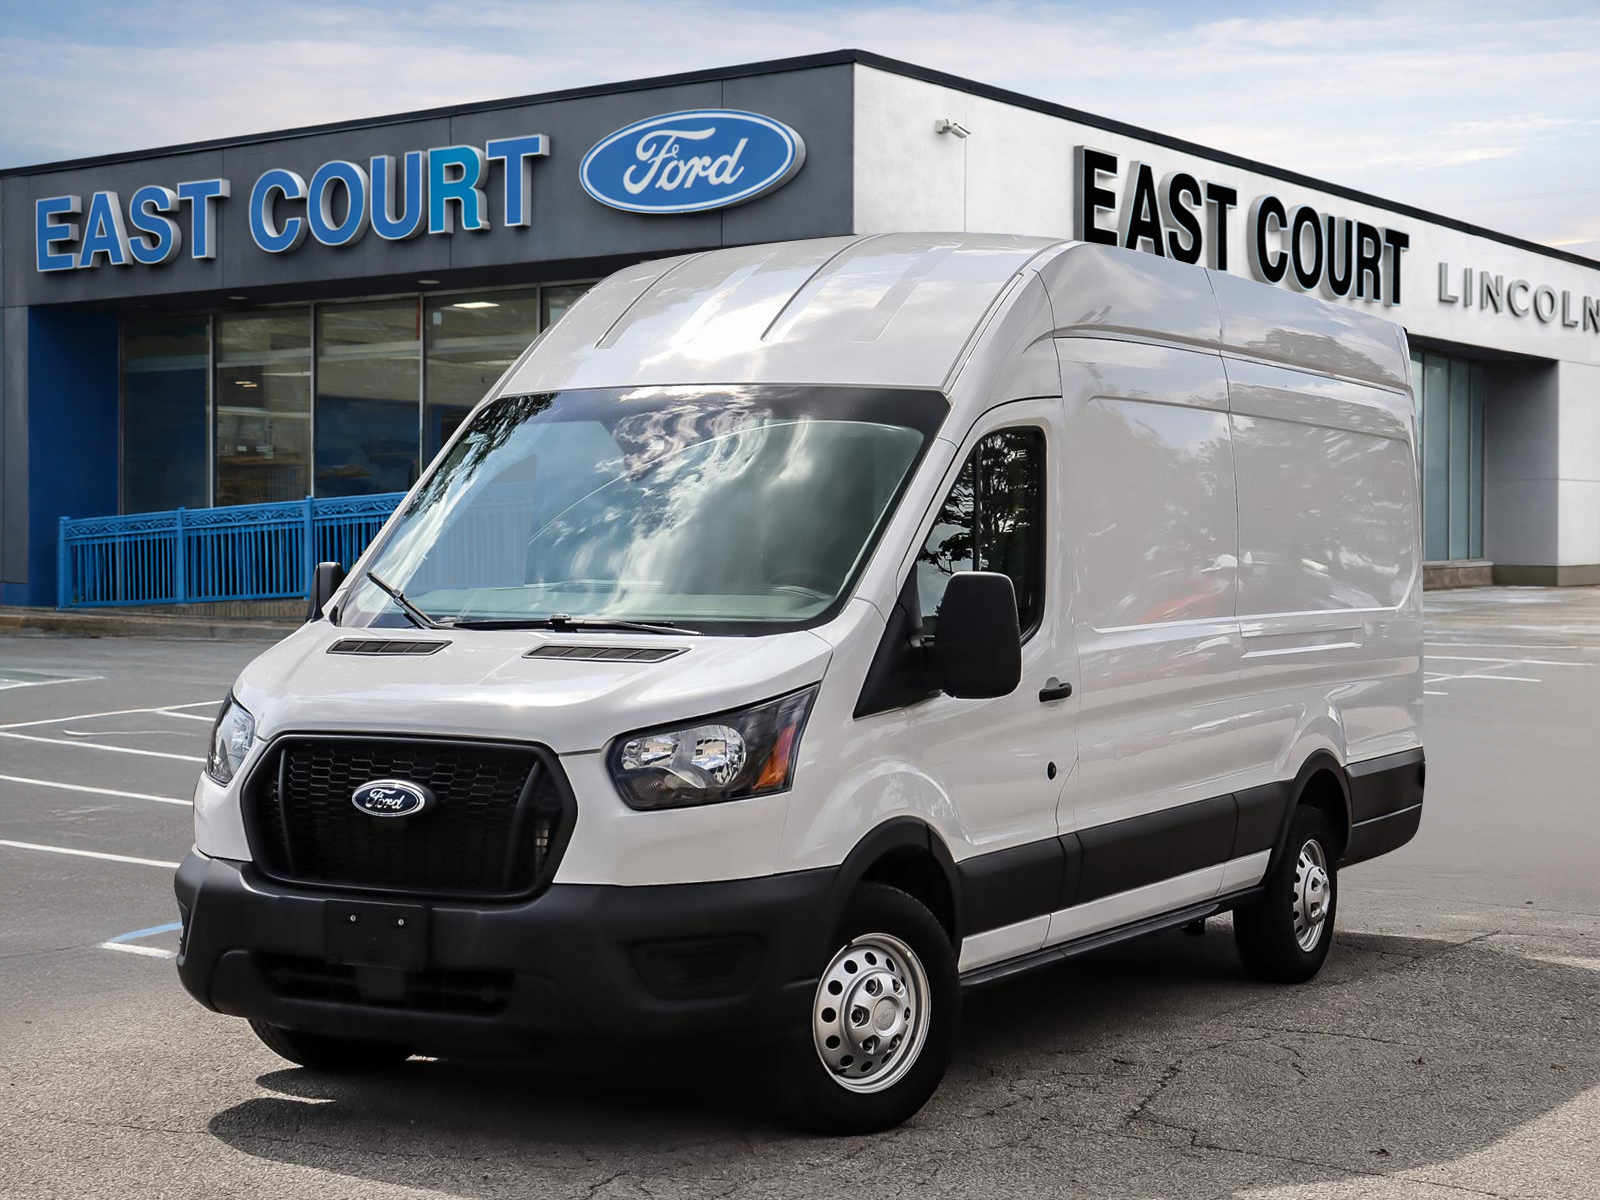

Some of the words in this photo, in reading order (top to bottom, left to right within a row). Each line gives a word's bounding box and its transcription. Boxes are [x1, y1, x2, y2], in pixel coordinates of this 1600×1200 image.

[36, 177, 230, 272] EAST
[249, 133, 550, 253] COURT
[623, 127, 749, 195] Ford
[1075, 145, 1238, 272] EAST
[1248, 193, 1409, 307] COURT
[1438, 262, 1600, 334] LINCOLN
[365, 788, 406, 809] Ford
